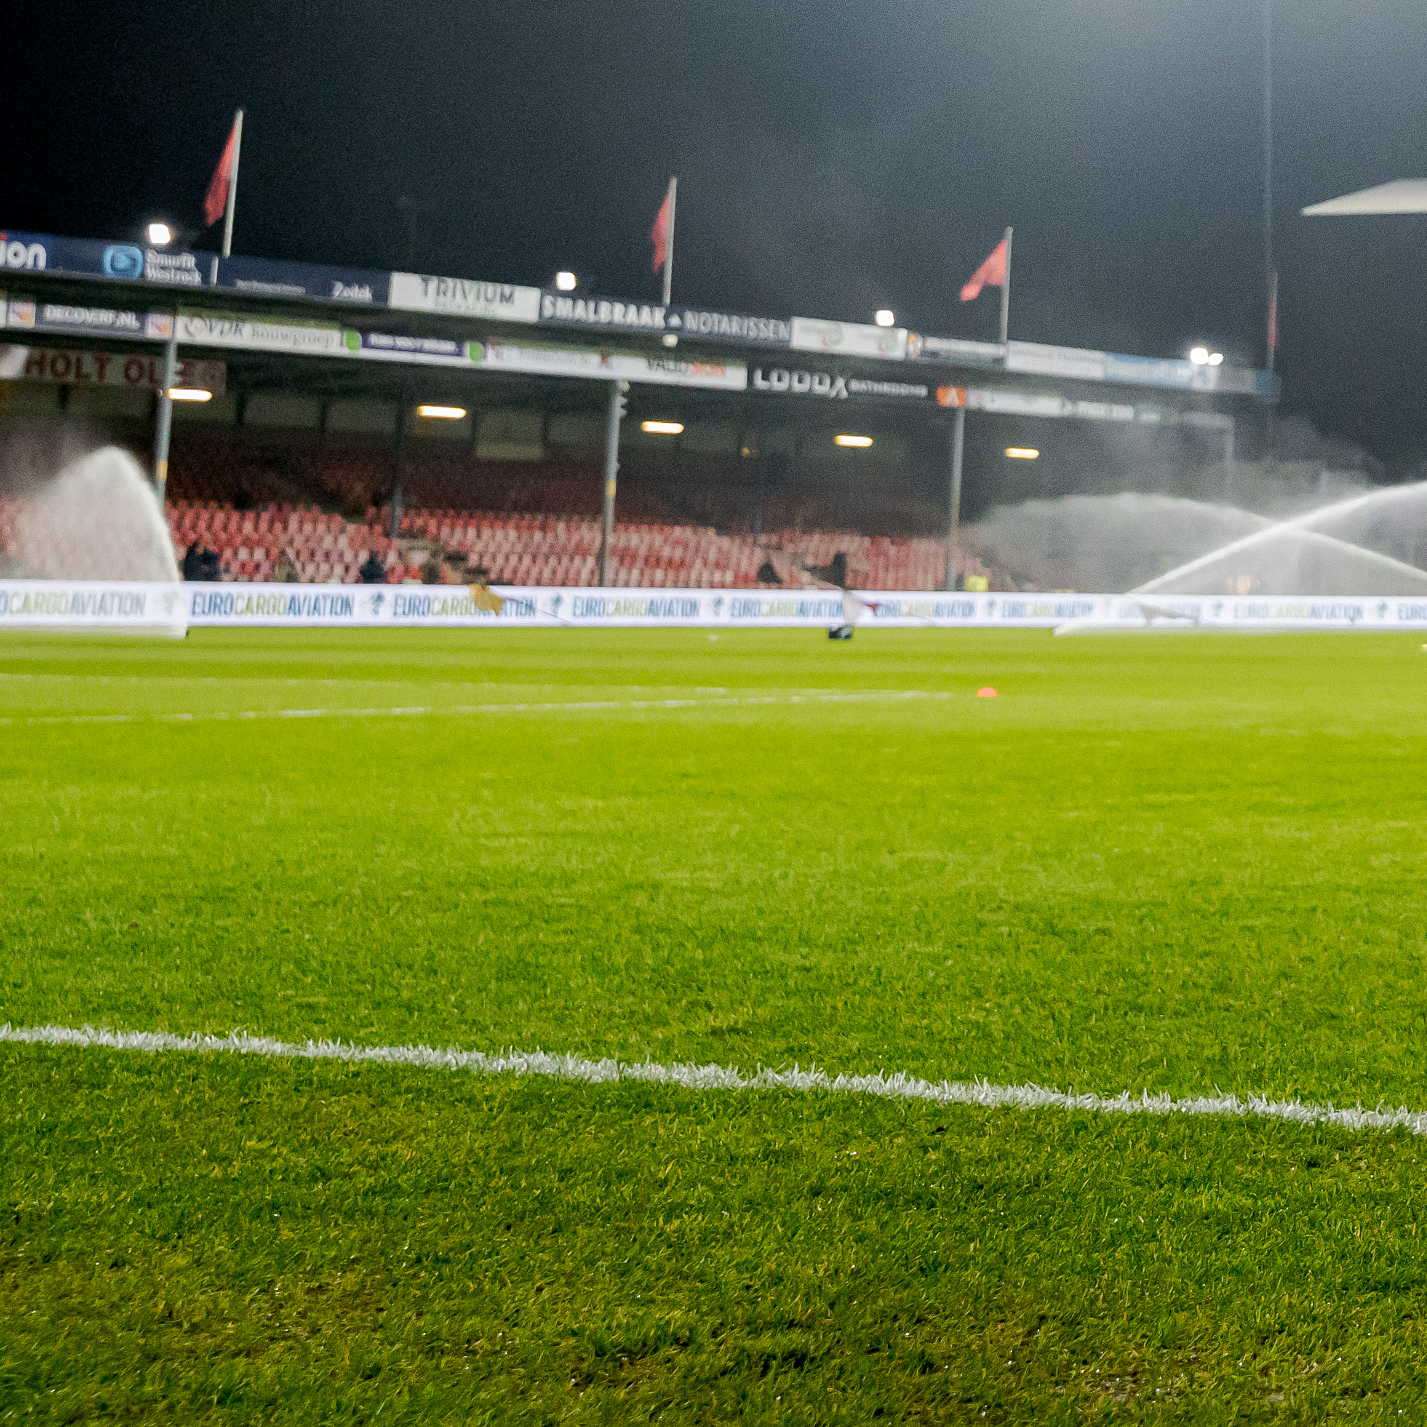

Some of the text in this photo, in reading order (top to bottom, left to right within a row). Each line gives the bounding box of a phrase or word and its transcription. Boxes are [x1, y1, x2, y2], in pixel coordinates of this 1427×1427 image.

[420, 275, 516, 305] TRIVIUM
[541, 294, 666, 329] SMALBRAAK
[191, 592, 355, 618] EUROCARGOAVIATION
[572, 596, 701, 618] EUROCARGOAVIATION
